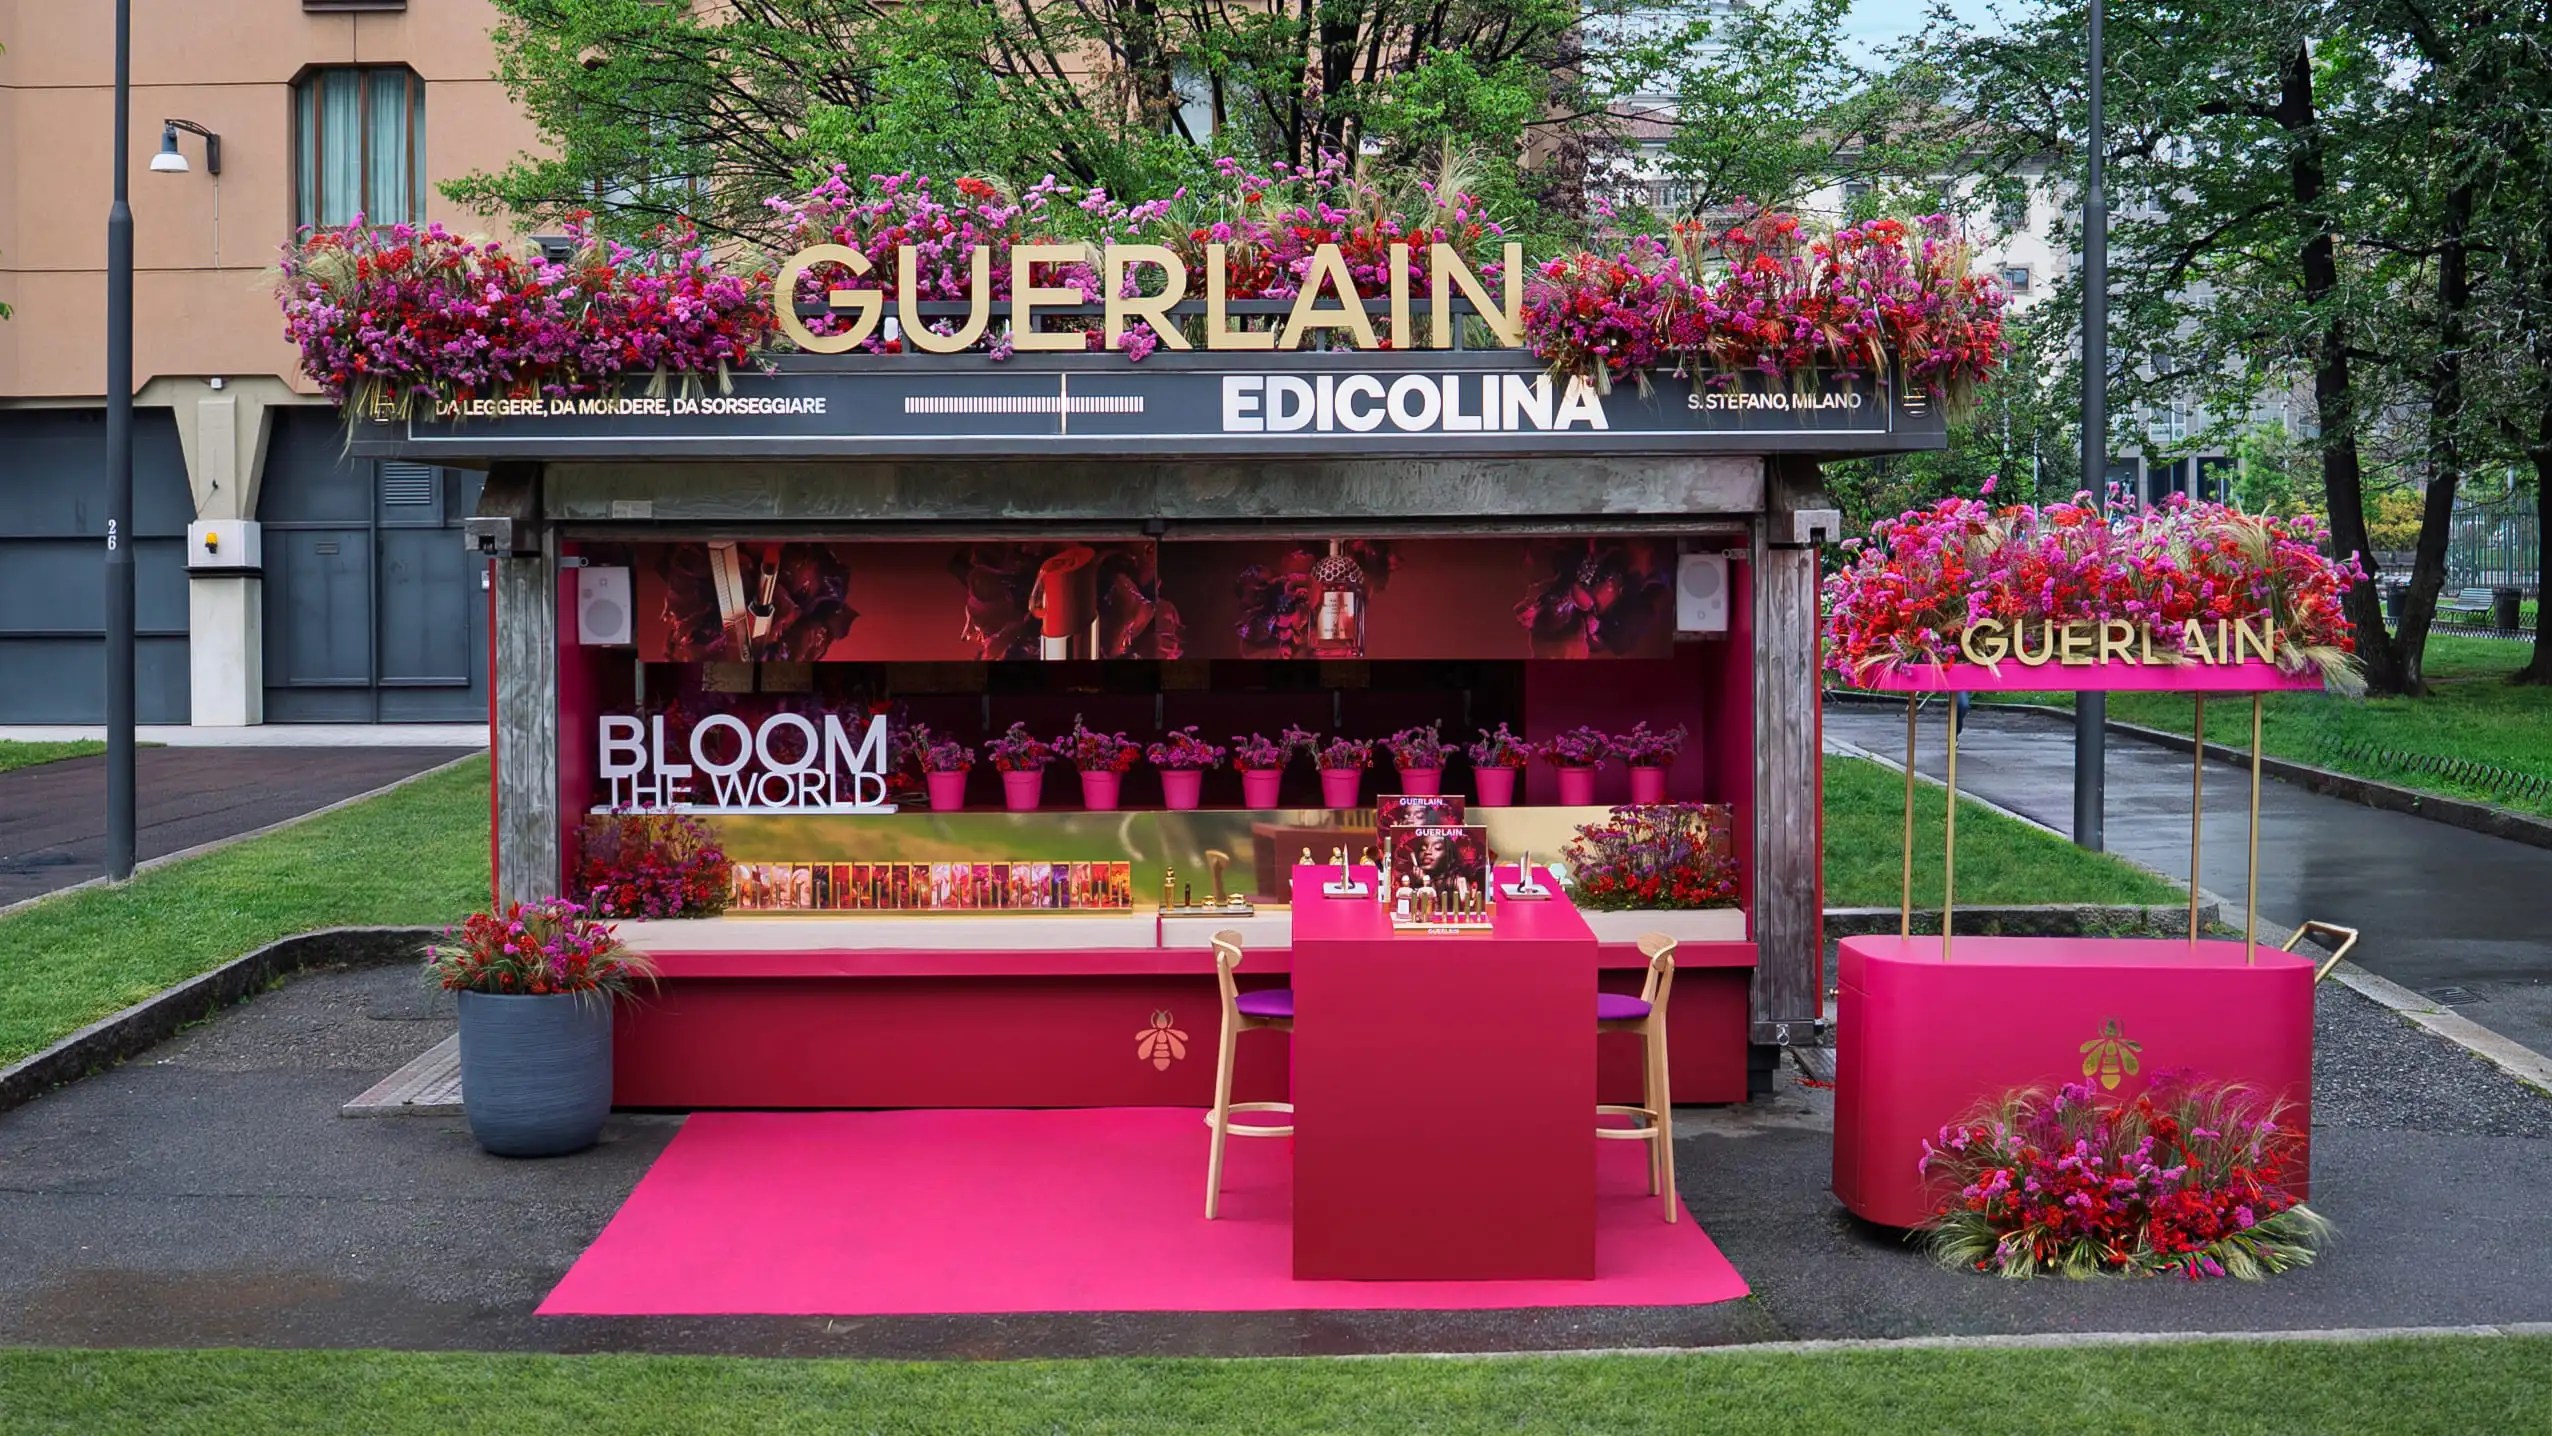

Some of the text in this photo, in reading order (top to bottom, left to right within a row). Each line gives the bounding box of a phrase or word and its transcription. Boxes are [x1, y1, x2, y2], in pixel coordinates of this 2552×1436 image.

[772, 242, 1527, 354] GUERLAIN
[464, 400, 548, 417] LEGGERE,
[551, 400, 575, 415] DA
[674, 399, 699, 415] DA
[701, 397, 826, 415] SORSEGGIARE
[1222, 375, 1610, 432] EDICOLINA
[1688, 393, 1861, 411] S. STEFANO, MILANO
[107, 518, 117, 551] 26
[1961, 618, 2274, 667] GUERLAIN
[600, 713, 887, 778] BLOOM
[611, 770, 887, 808] THE WORLD
[1400, 798, 1443, 806] GUERLAIN
[1415, 829, 1463, 837] GUERLAIN
